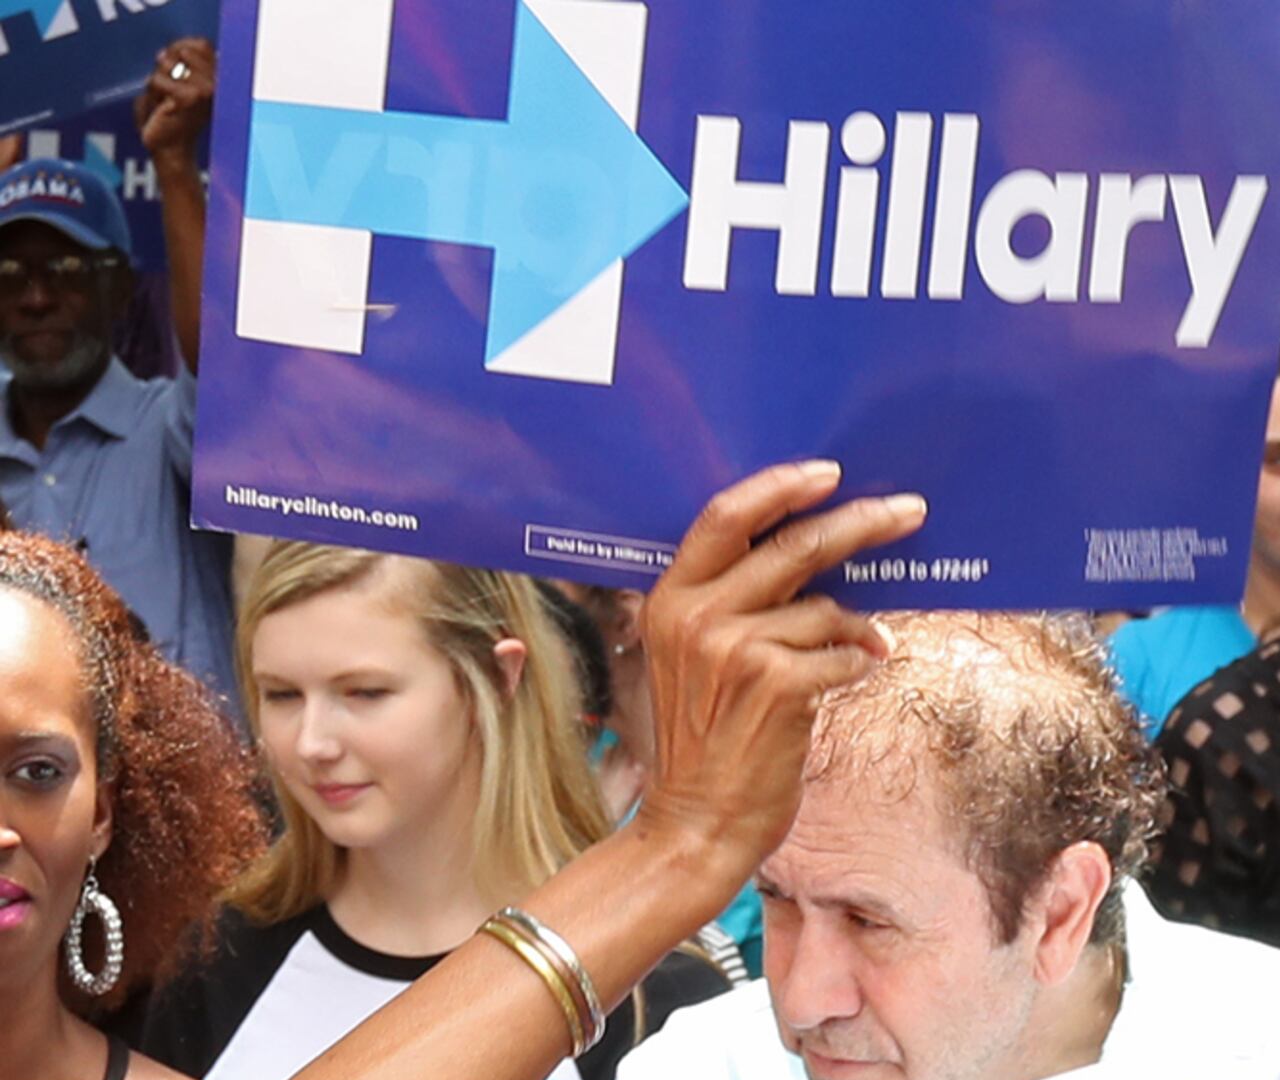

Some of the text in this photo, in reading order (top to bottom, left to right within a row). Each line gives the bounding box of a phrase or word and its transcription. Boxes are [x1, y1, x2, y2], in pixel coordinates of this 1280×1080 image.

[0, 176, 84, 207] OBAMA
[683, 110, 1268, 348] Hillary
[226, 485, 418, 531] hillaryclinton.com
[547, 535, 575, 554] Paid
[597, 543, 612, 561] by
[614, 546, 653, 566] Hillary
[843, 558, 877, 584] Text
[909, 558, 928, 583] to
